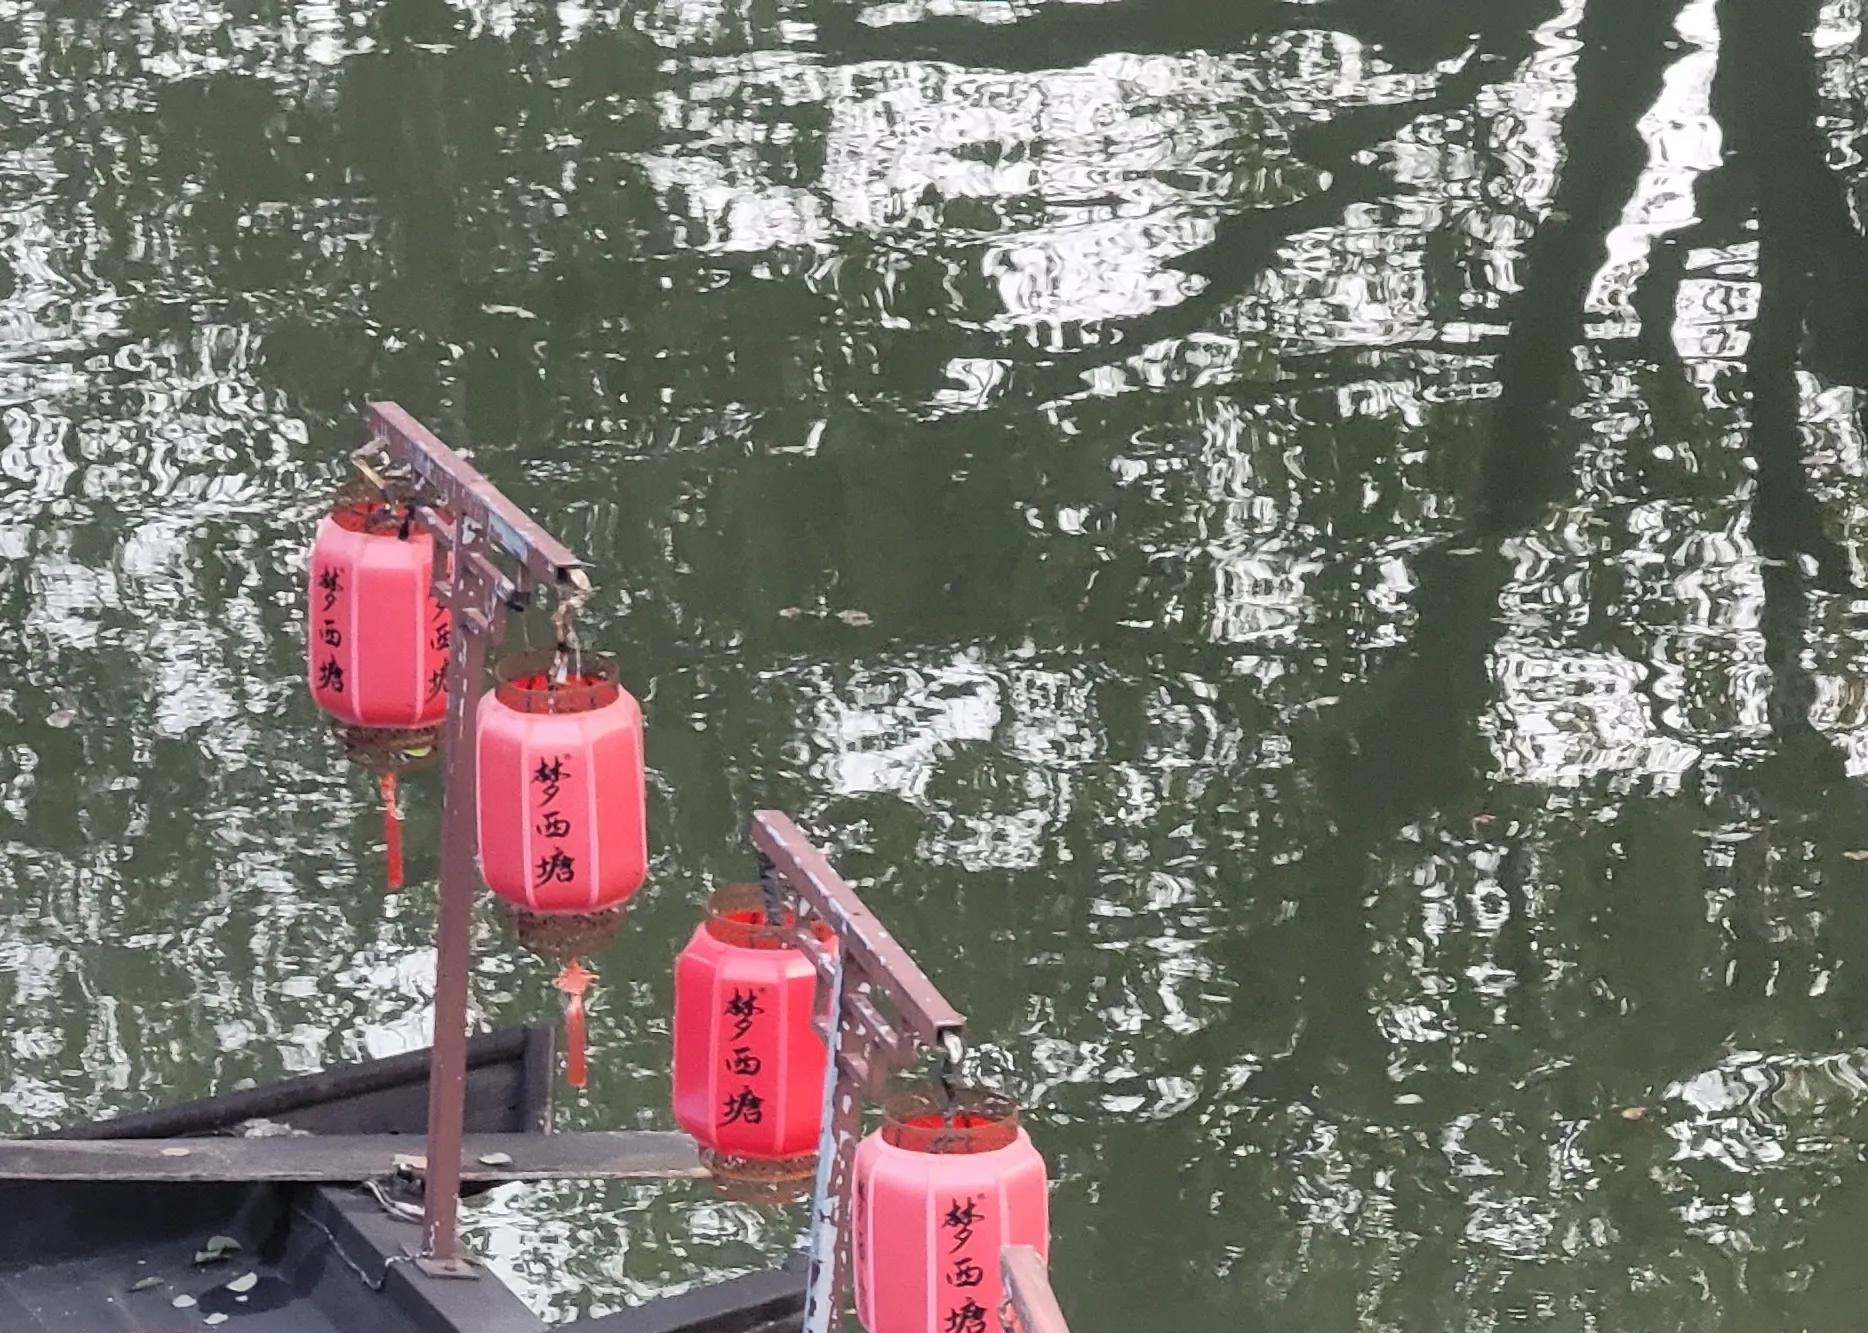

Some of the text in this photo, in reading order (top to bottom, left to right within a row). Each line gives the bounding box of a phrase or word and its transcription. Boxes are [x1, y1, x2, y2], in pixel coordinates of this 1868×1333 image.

[317, 565, 345, 694] 梦西塘
[531, 756, 576, 888] 梦西塘
[720, 988, 765, 1127] 梦西塘
